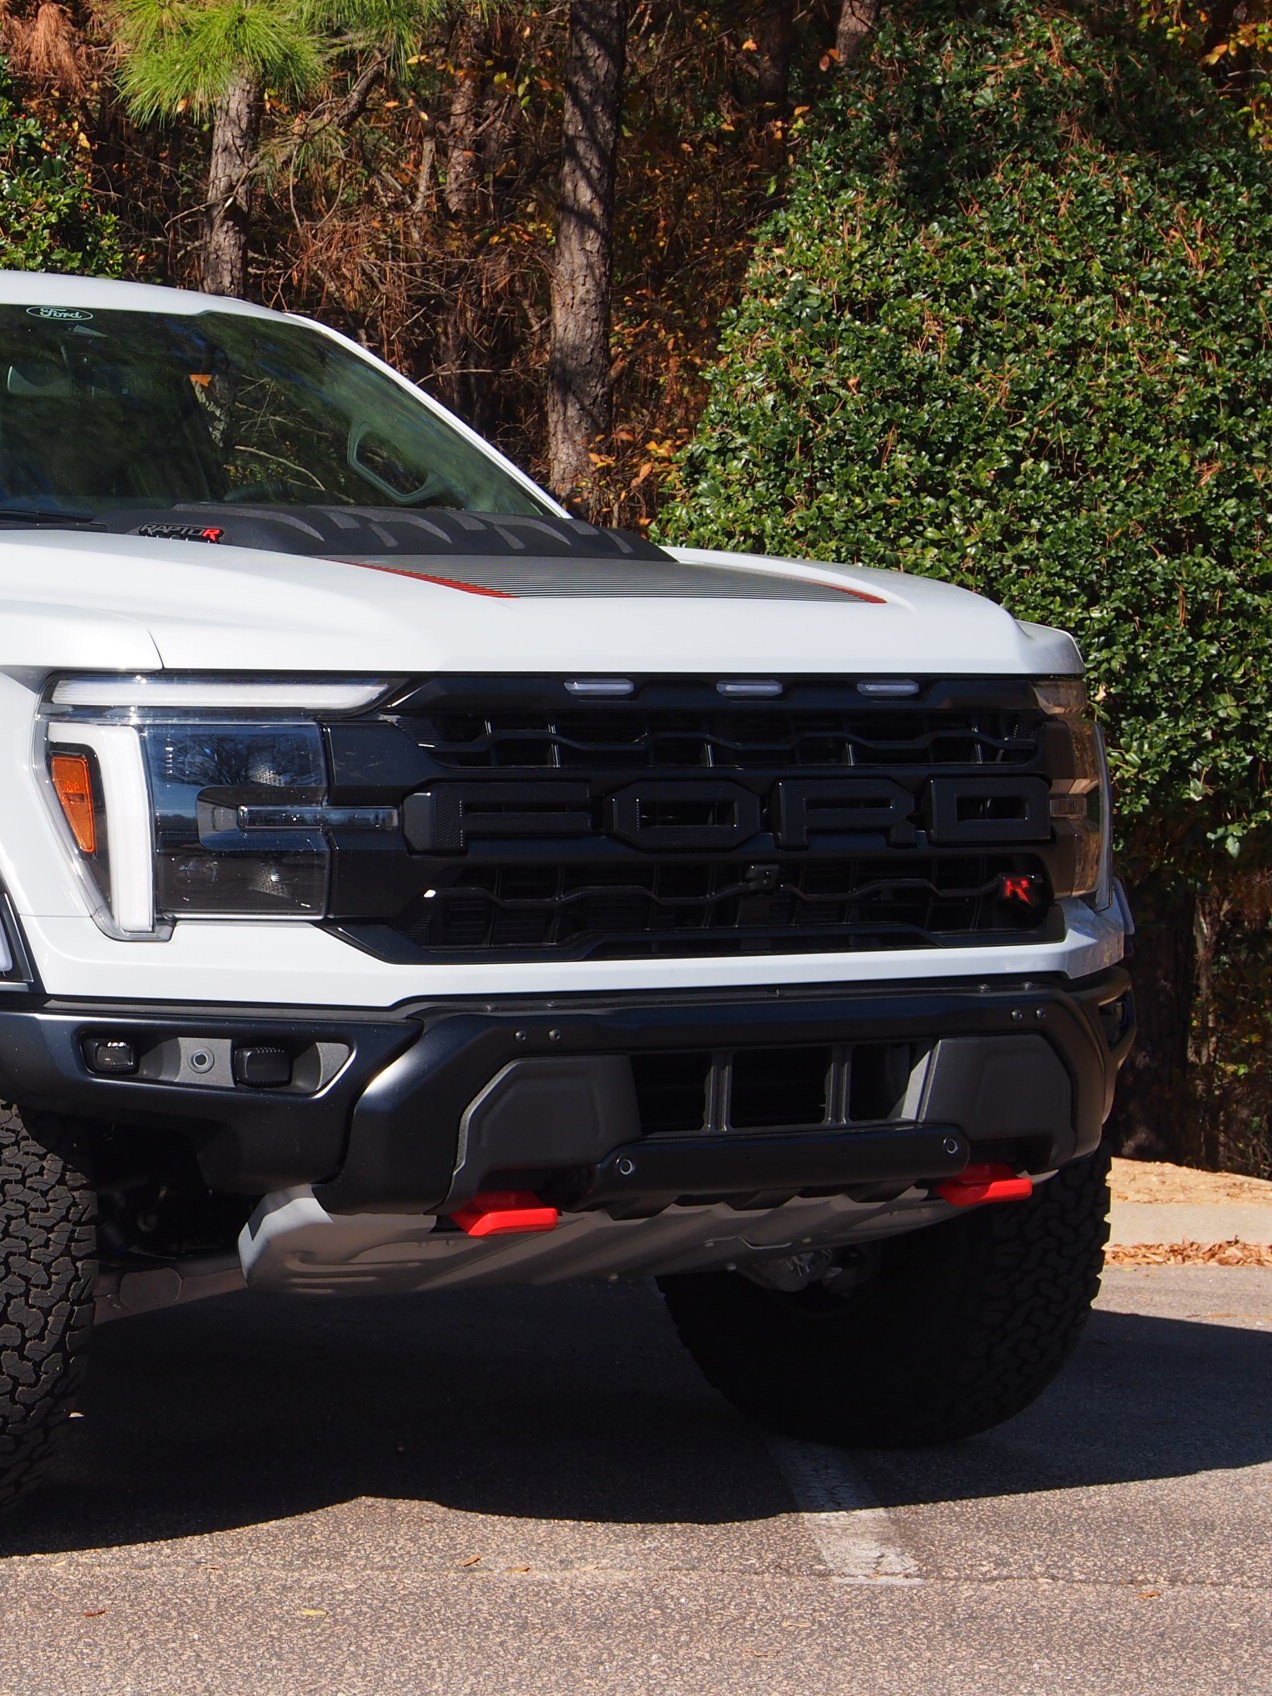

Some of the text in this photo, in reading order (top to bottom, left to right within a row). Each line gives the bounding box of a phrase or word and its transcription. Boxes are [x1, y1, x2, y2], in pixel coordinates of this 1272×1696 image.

[39, 307, 83, 319] Ford
[140, 524, 221, 542] RAPTOR
[403, 777, 1051, 855] FORD
[1004, 878, 1031, 903] R
